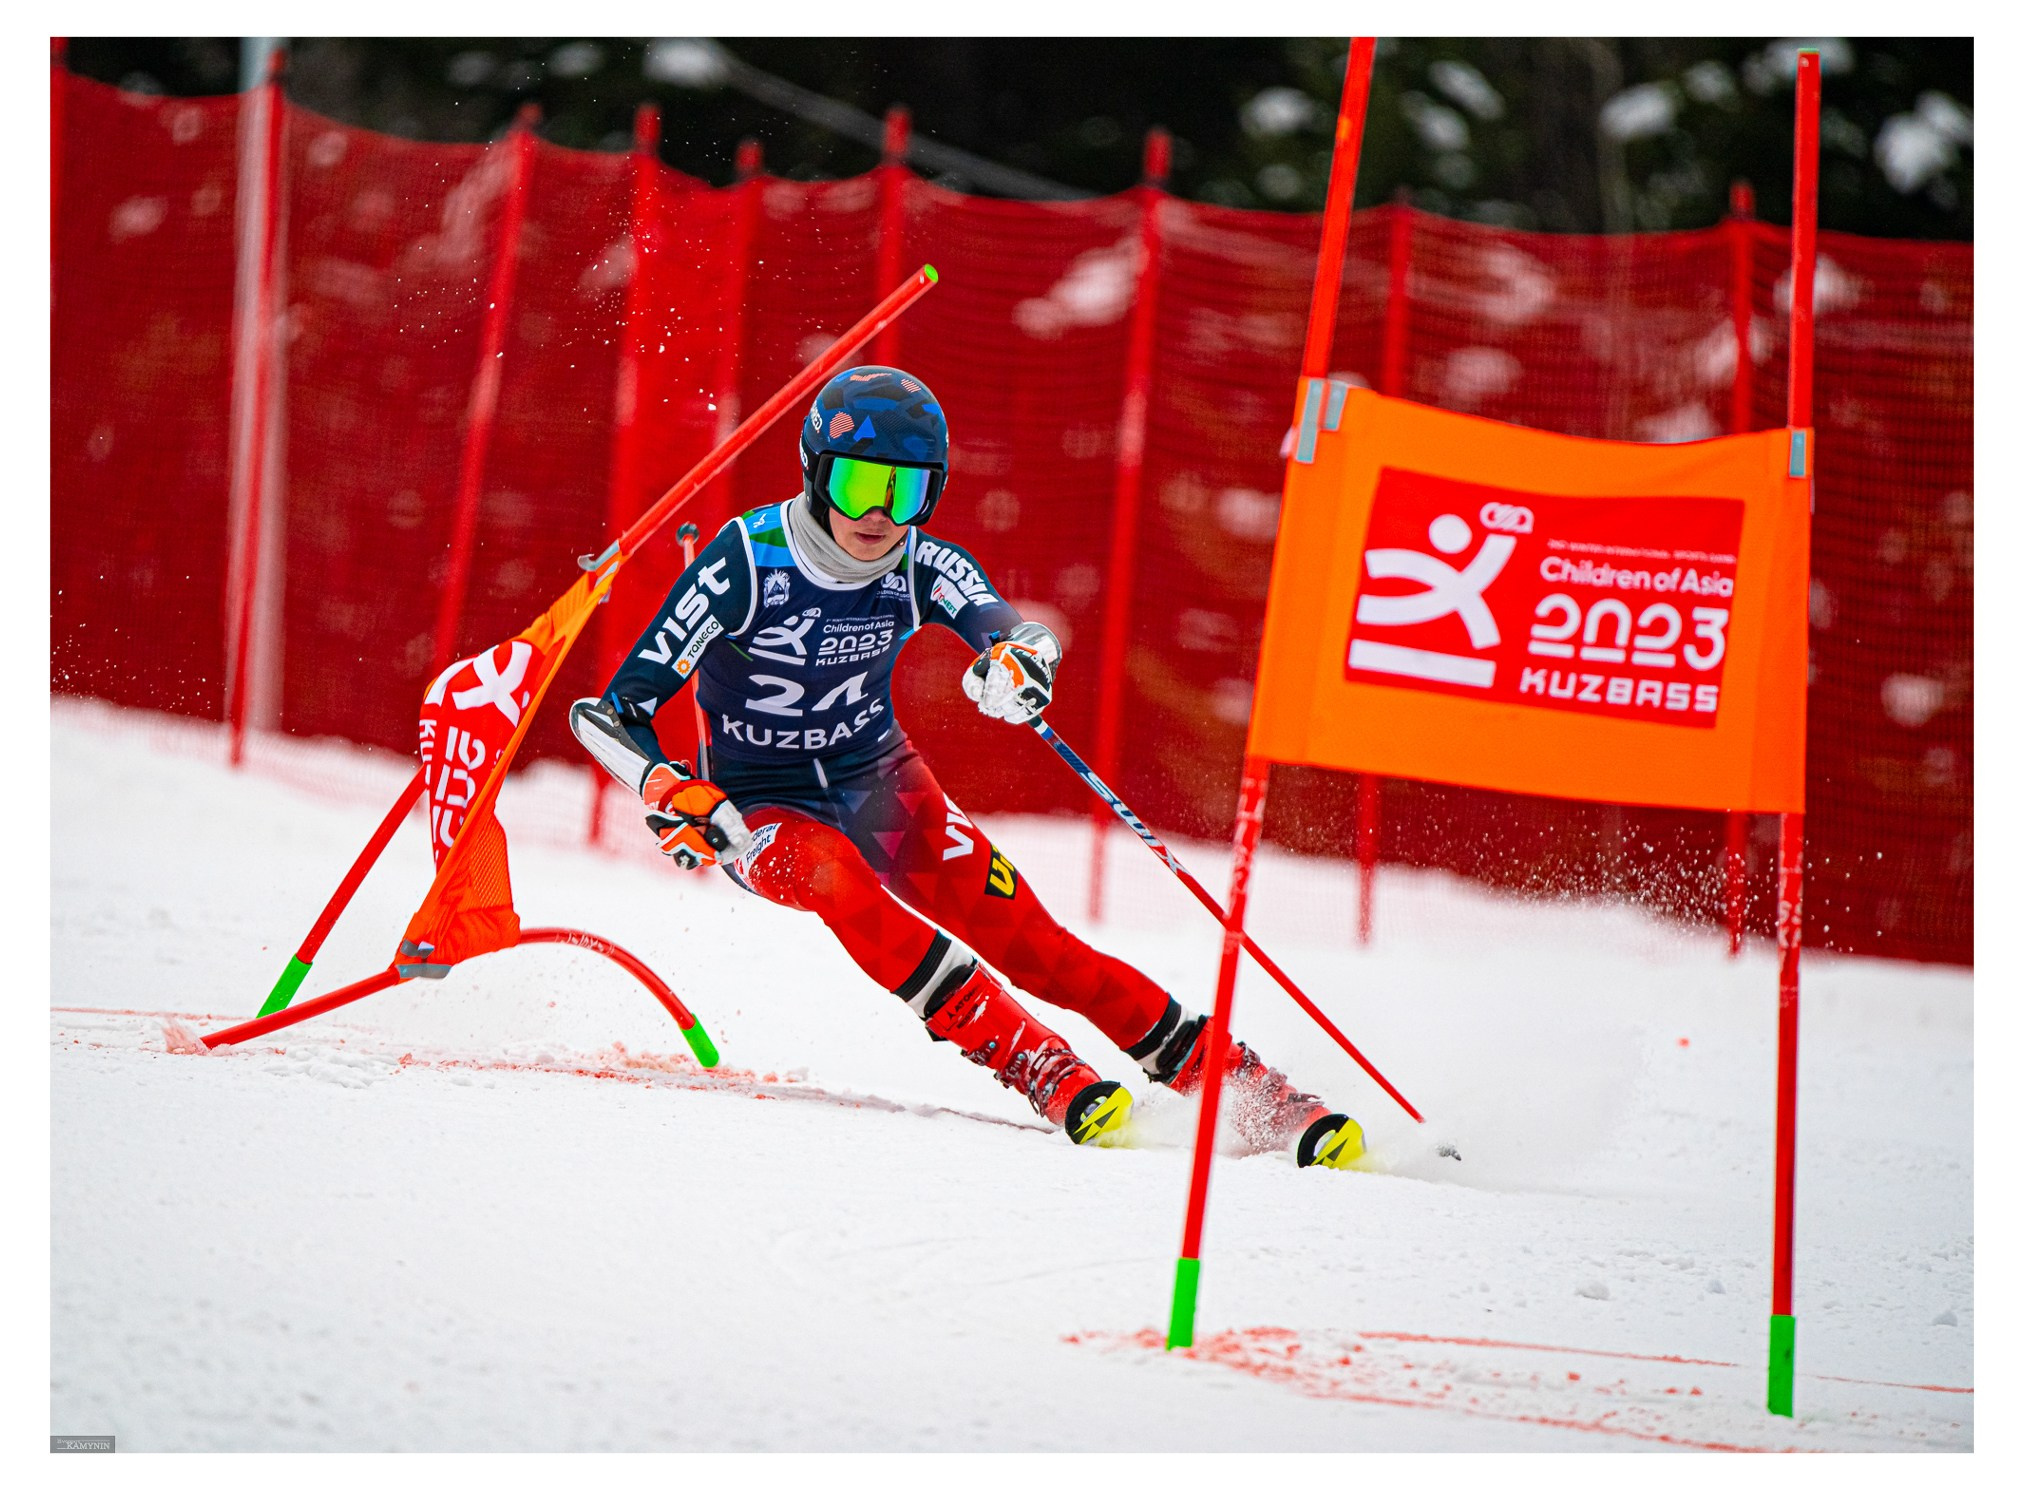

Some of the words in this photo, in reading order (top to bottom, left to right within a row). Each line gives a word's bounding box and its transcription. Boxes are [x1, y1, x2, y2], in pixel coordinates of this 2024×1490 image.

[915, 541, 998, 606] RUSSIA
[1540, 556, 1651, 590] Children
[1653, 567, 1682, 592] of
[1680, 568, 1734, 597] Asia
[818, 629, 894, 656] 2023
[823, 623, 864, 634] Children
[864, 622, 874, 630] of
[874, 620, 895, 629] Asia
[1528, 593, 1729, 671] 2023
[1519, 666, 1719, 713] KUZBASS
[721, 697, 885, 750] KUZBASS
